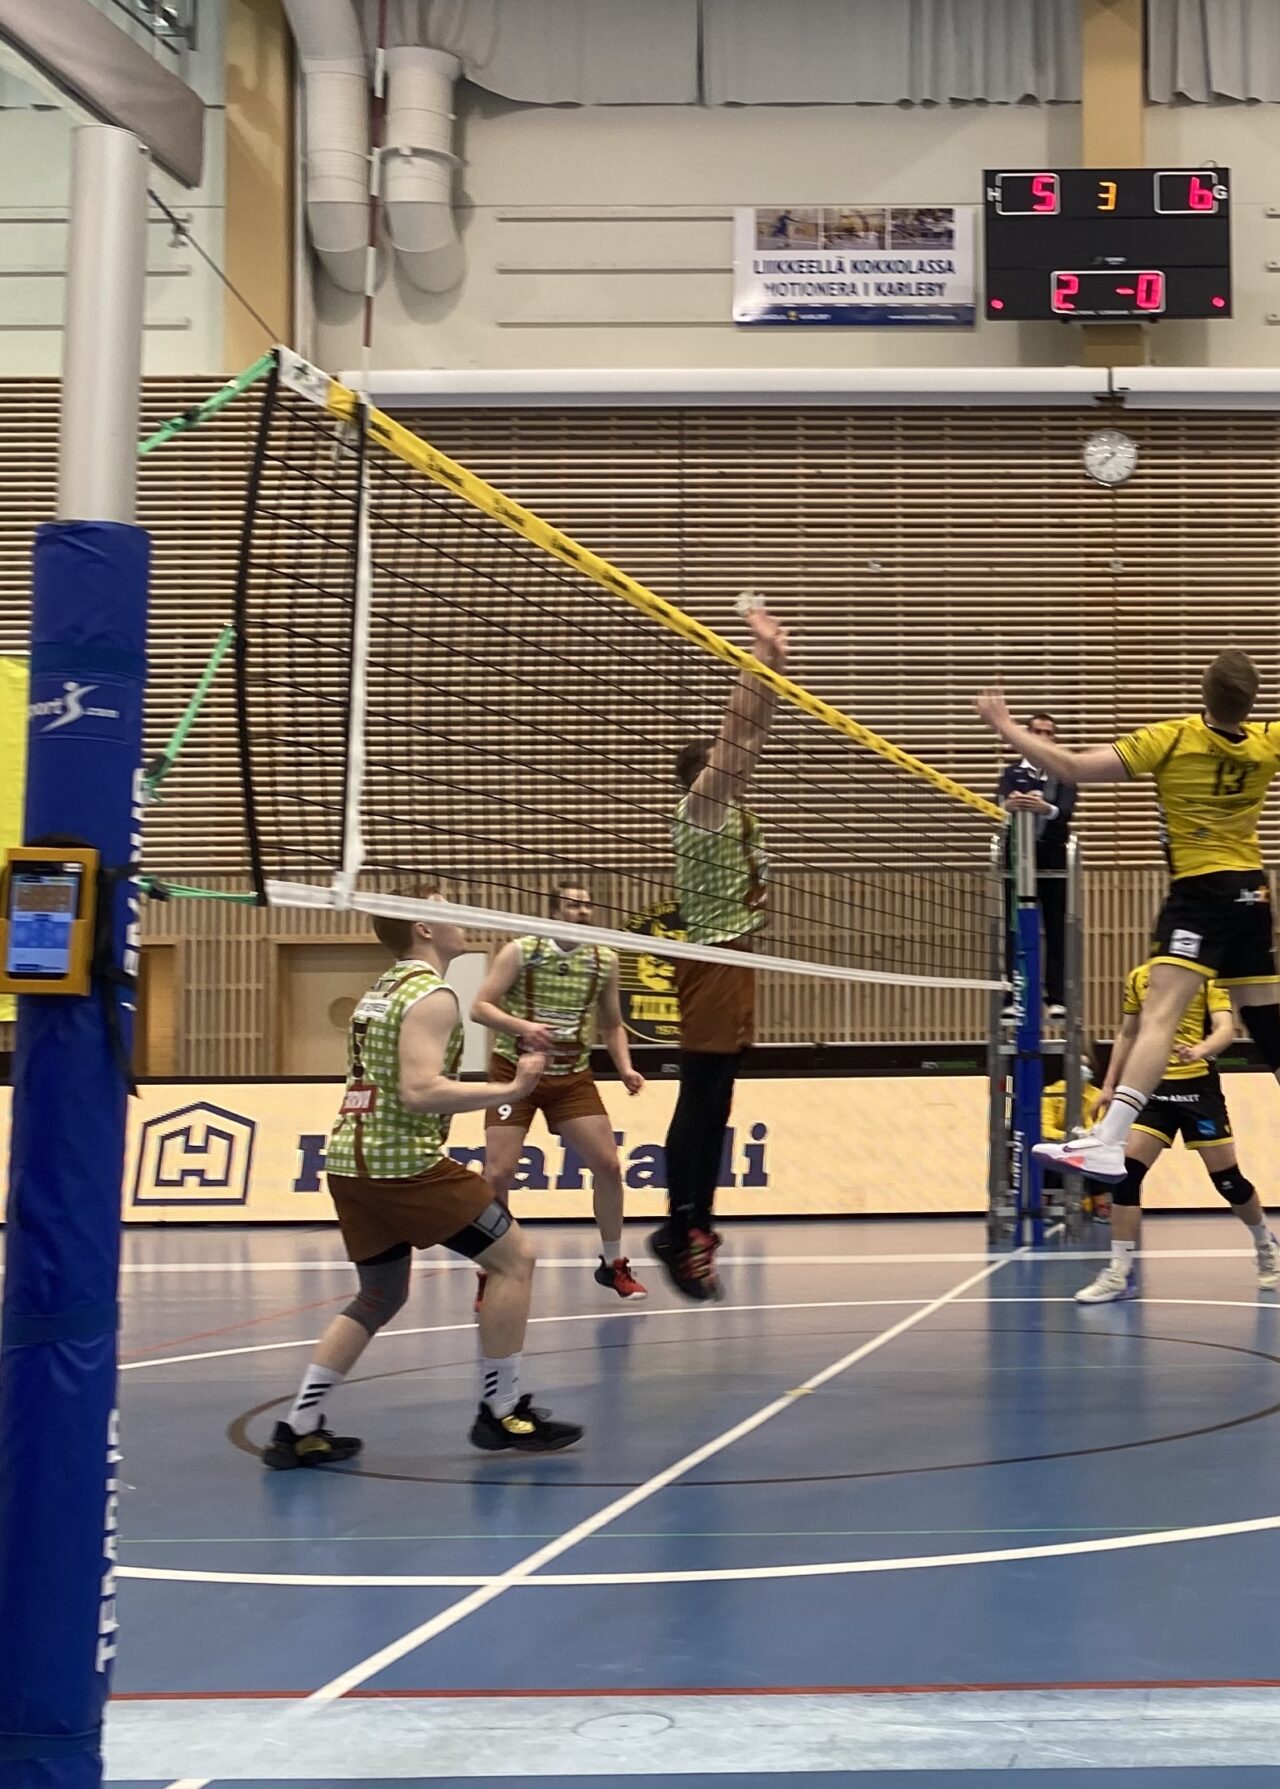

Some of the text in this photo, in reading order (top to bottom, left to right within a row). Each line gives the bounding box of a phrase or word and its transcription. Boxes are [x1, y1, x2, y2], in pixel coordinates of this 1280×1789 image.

[987, 187, 1001, 201] H
[1032, 176, 1056, 211] 5
[1097, 182, 1118, 210] 3
[1212, 185, 1228, 199] G
[753, 256, 956, 274] LIIKKEELLÄ KOKKOLASSA
[874, 282, 947, 296] KARLEBY
[1054, 274, 1079, 309] 2
[1212, 759, 1249, 796] 13
[498, 1102, 512, 1121] 9
